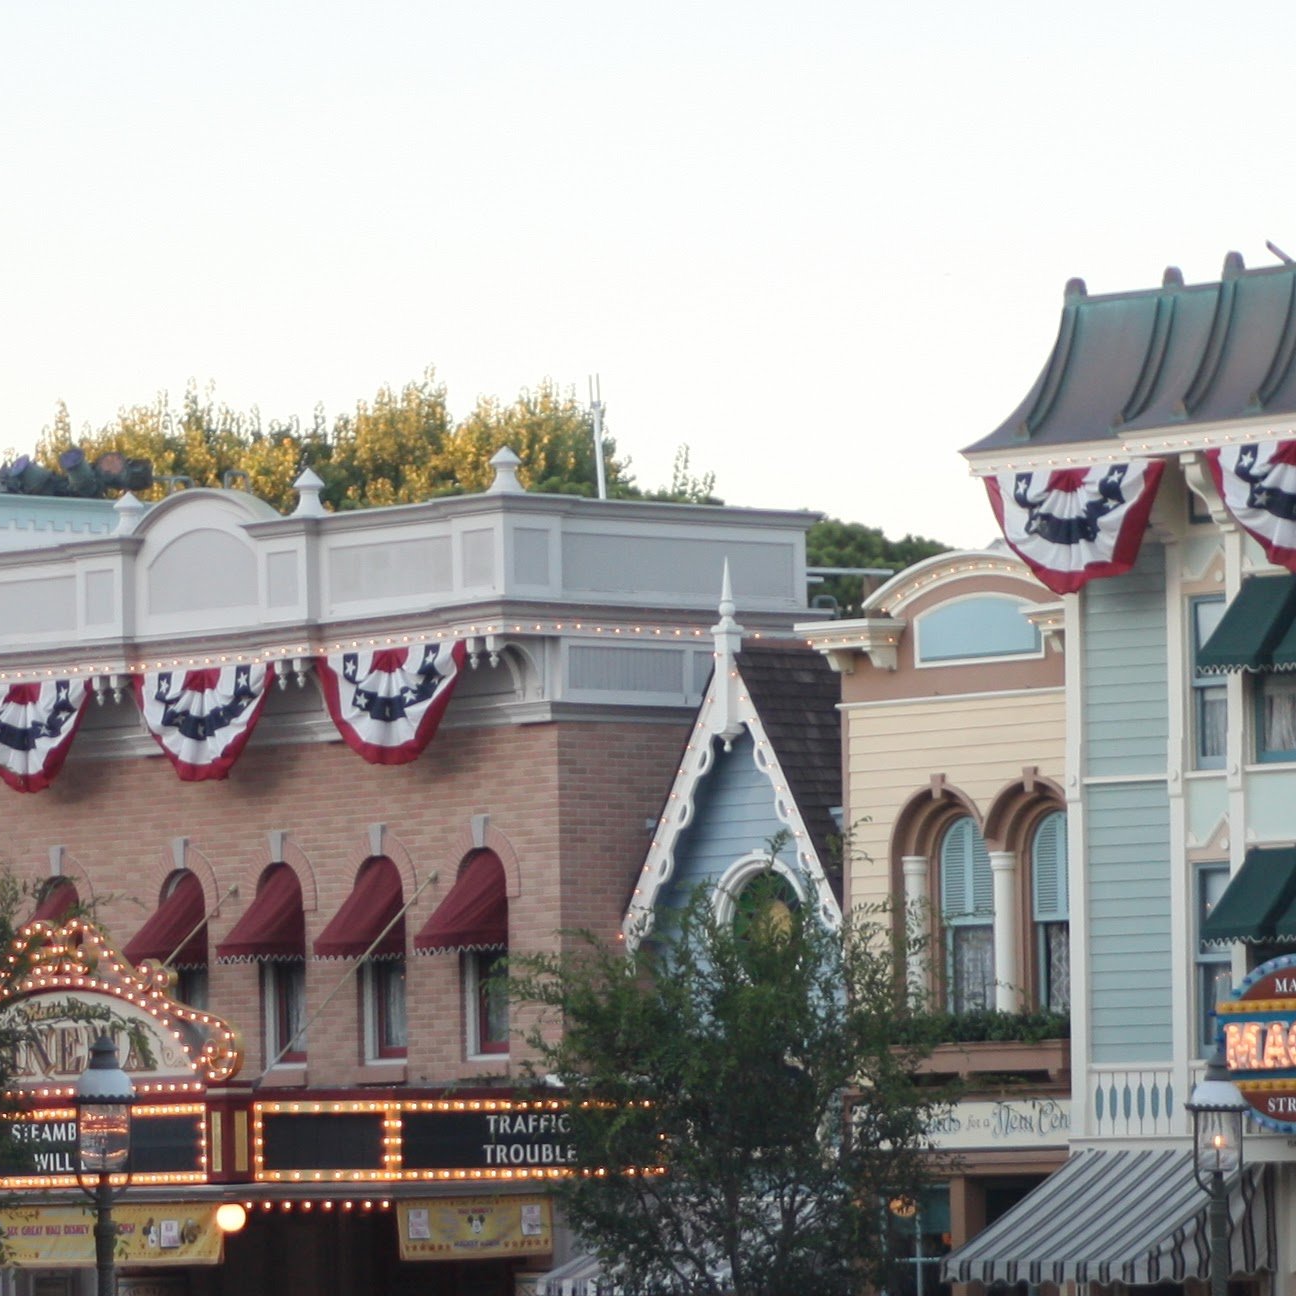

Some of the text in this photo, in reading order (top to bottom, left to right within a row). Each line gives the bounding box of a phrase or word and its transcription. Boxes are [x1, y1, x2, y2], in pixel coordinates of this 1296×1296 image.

[12, 1121, 77, 1143] STEAMB
[486, 1114, 571, 1133] TRAFFIC
[483, 1143, 579, 1164] TROUBLE
